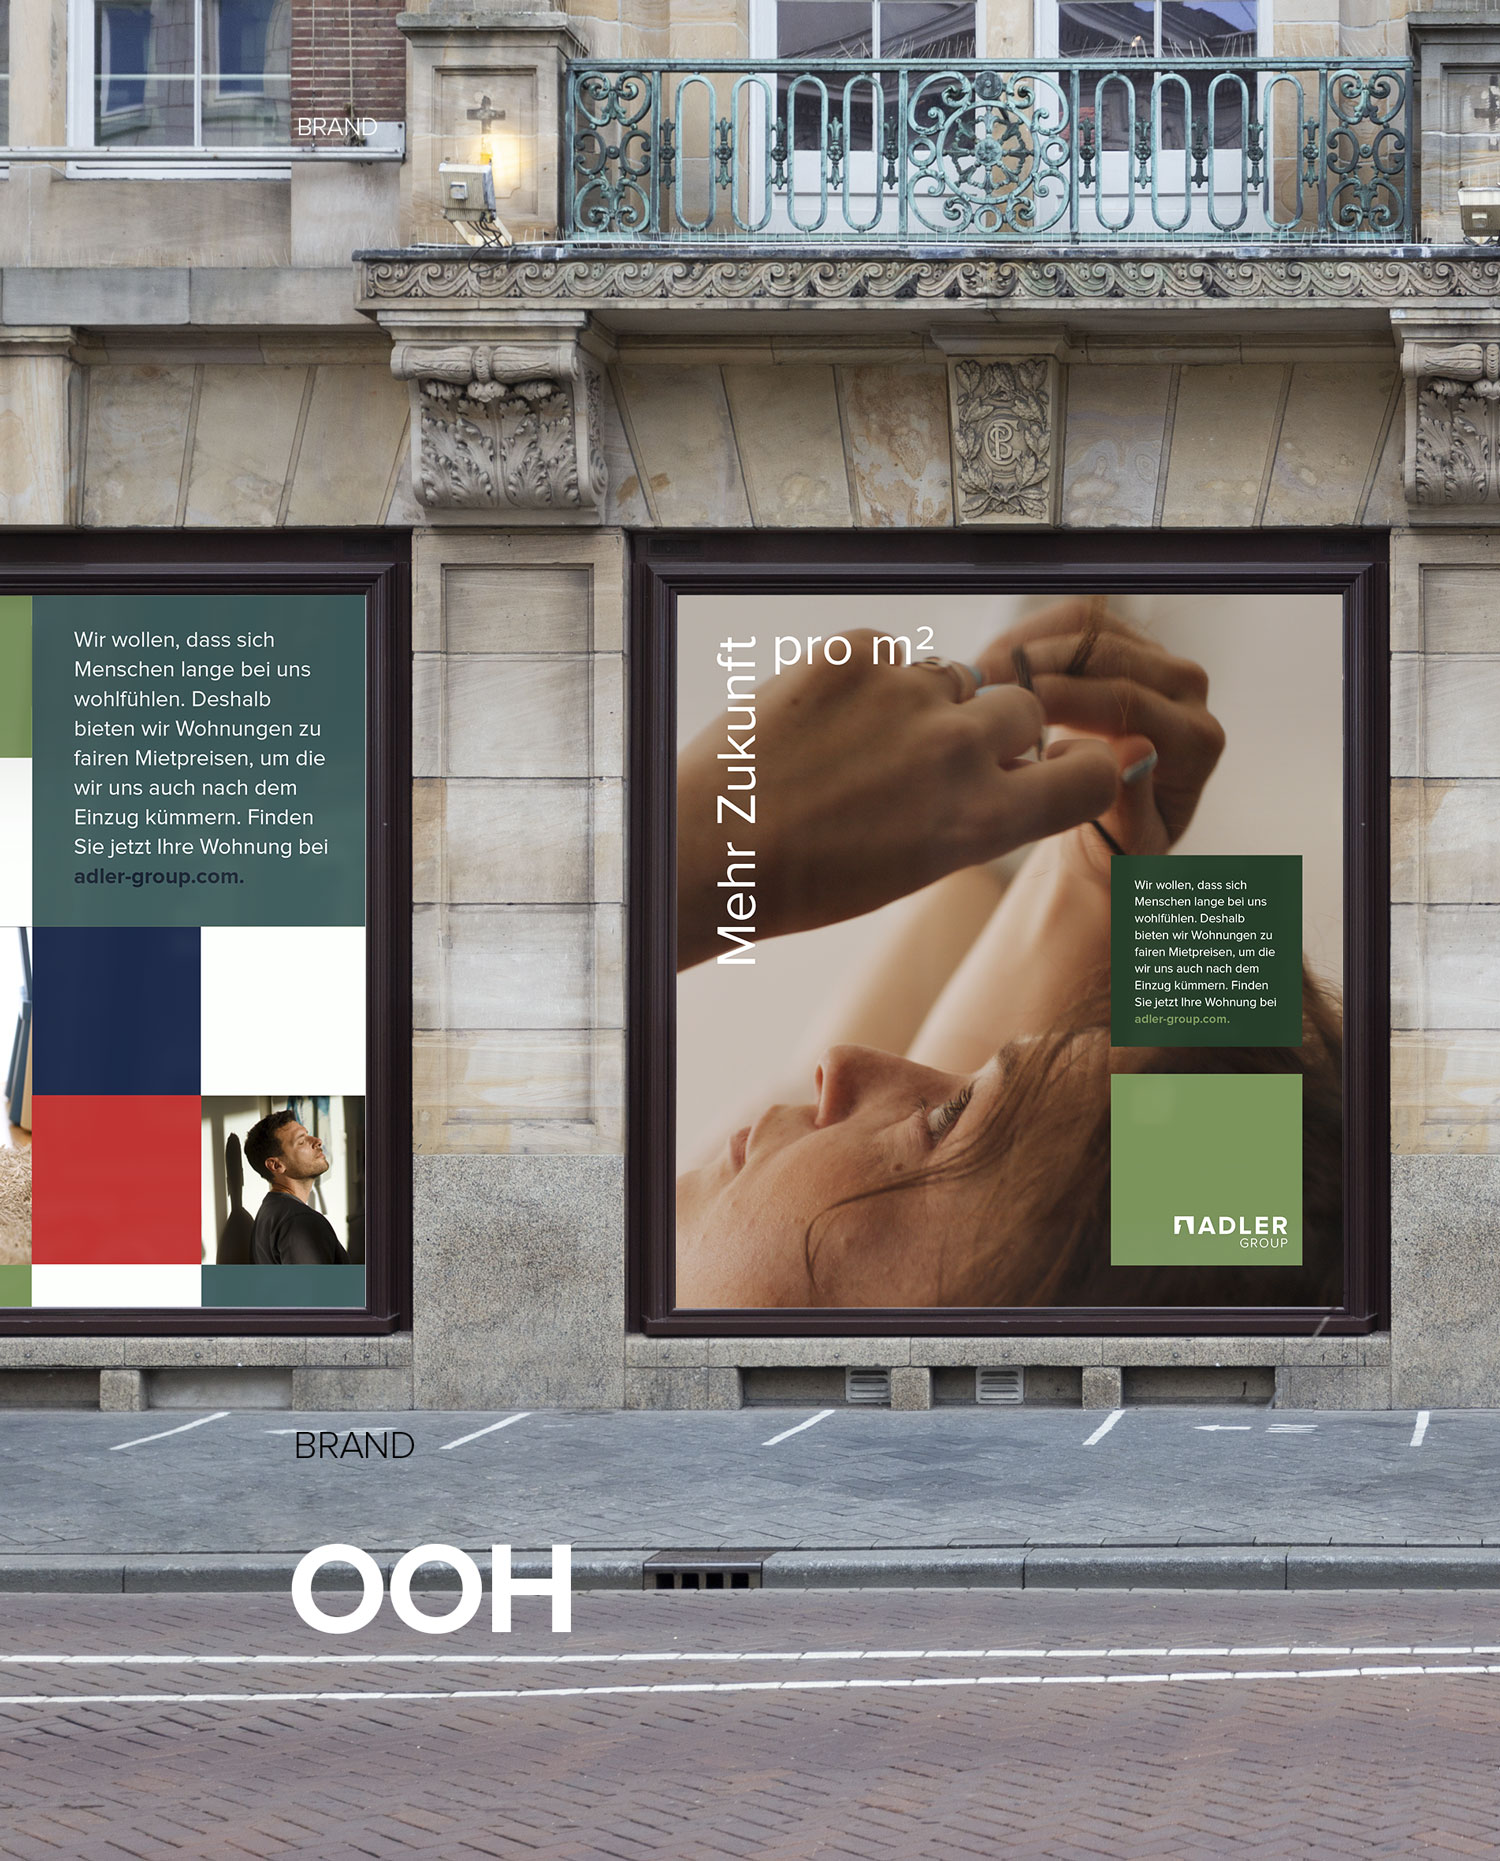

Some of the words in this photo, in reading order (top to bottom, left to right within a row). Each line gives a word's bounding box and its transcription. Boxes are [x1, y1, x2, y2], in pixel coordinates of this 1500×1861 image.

[74, 632, 106, 647] Wir
[112, 632, 179, 650] wollen,
[187, 632, 230, 647] dass
[237, 632, 274, 647] sich
[774, 634, 852, 675] pro
[75, 661, 173, 677] Menschen
[182, 661, 234, 681] lange
[242, 661, 270, 677] bei
[278, 665, 310, 677] uns
[74, 691, 184, 707] wohlfühlen.
[193, 691, 270, 706] Deshalb
[75, 721, 134, 736] bieten
[141, 721, 170, 736] wir
[176, 720, 292, 740] Wohnungen
[299, 724, 320, 736] zu
[717, 636, 757, 824] Zukunft
[74, 750, 128, 766] fairen
[136, 750, 253, 770] Mietpreisen,
[261, 754, 288, 766] um
[296, 750, 325, 766] die
[74, 780, 102, 795] wir
[110, 784, 142, 795] uns
[149, 779, 194, 795] auch
[203, 779, 247, 795] nach
[255, 780, 296, 795] dem
[75, 809, 138, 829] Einzug
[146, 809, 240, 825] kümmern.
[249, 809, 313, 825] Finden
[75, 838, 104, 854] Sie
[108, 839, 151, 858] jetzt
[158, 838, 193, 854] Ihre
[200, 838, 291, 858] Wohnung
[300, 839, 328, 854] bei
[75, 868, 244, 888] adler-group.com.
[1134, 880, 1152, 889] Wir
[1156, 880, 1194, 891] wollen,
[1197, 880, 1222, 889] dass
[1226, 880, 1247, 889] sich
[717, 842, 757, 964] Mehr
[1135, 897, 1191, 906] Menschen
[1195, 897, 1224, 908] lange
[1228, 897, 1244, 906] bei
[1135, 913, 1197, 923] wohlfühlen.
[1200, 913, 1245, 923] Deshalb
[1135, 931, 1168, 940] bieten
[1172, 931, 1188, 940] wir
[1191, 930, 1256, 942] Wohnungen
[1260, 932, 1272, 940] zu
[1135, 947, 1165, 956] fairen
[1169, 947, 1235, 958] Mietpreisen,
[1259, 948, 1275, 956] die
[1135, 964, 1151, 973] wir
[1177, 964, 1202, 973] auch
[1206, 964, 1232, 973] nach
[1235, 964, 1259, 973] dem
[1135, 980, 1171, 992] Einzug
[1175, 981, 1228, 990] kümmern.
[1232, 980, 1268, 990] Finden
[1135, 997, 1152, 1007] Sie
[1154, 998, 1178, 1009] jetzt
[1182, 997, 1202, 1007] Ihre
[1205, 997, 1256, 1009] Wohnung
[1260, 997, 1276, 1007] bei
[1135, 1014, 1230, 1025] adler-group.com.
[1197, 1216, 1288, 1235] ADLER
[1239, 1238, 1288, 1248] GROUP
